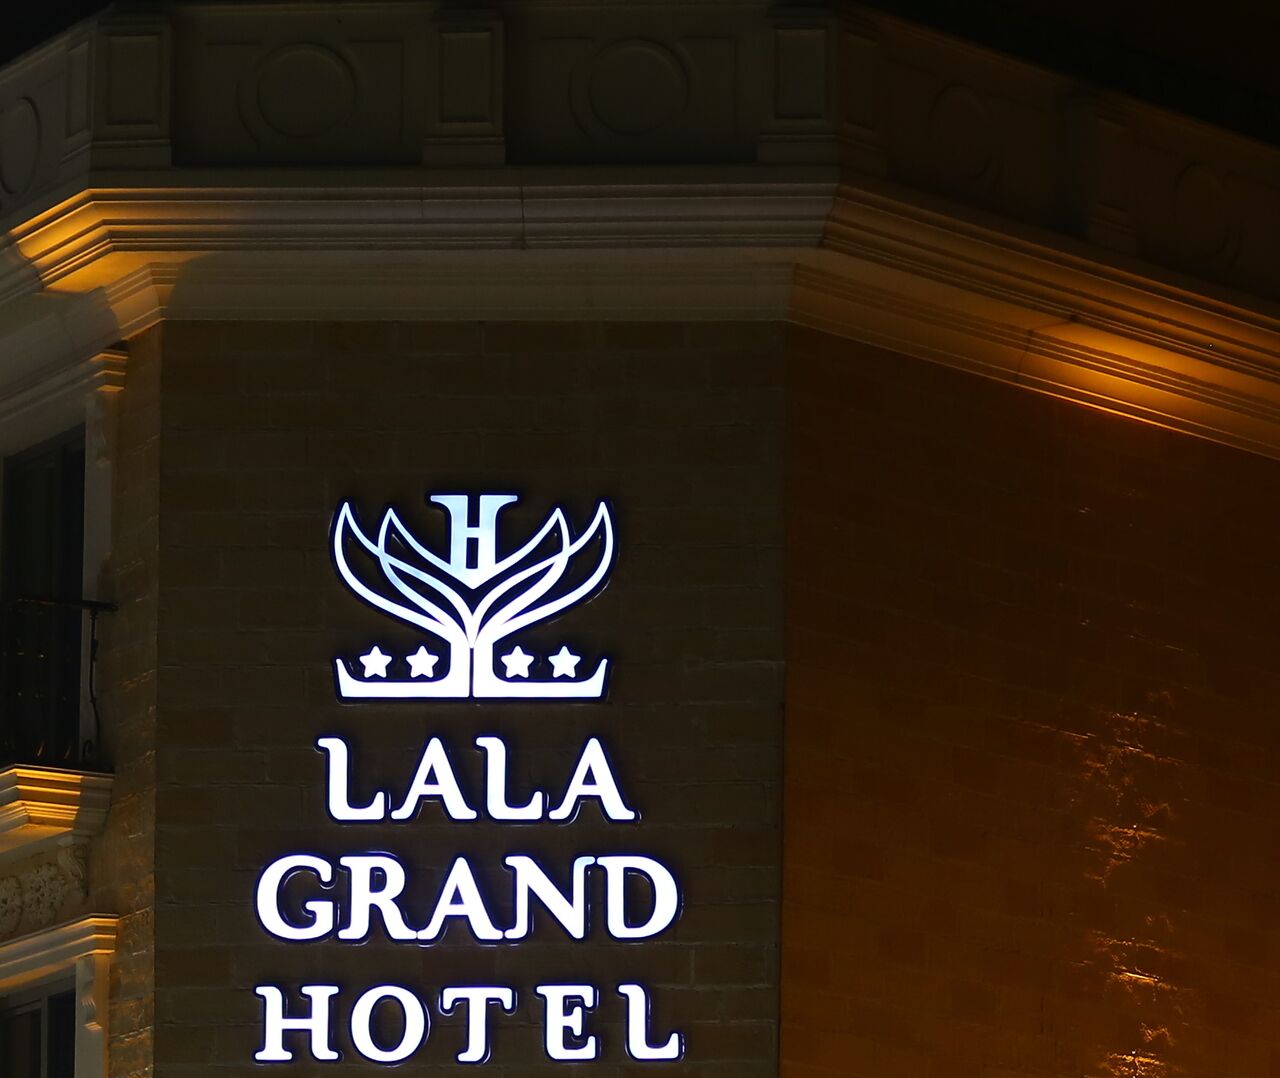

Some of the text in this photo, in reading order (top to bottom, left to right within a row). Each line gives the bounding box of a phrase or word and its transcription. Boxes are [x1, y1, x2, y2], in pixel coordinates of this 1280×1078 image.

[317, 736, 636, 821] LALA
[255, 854, 680, 940] GRAND
[255, 984, 680, 1063] HOTEL
